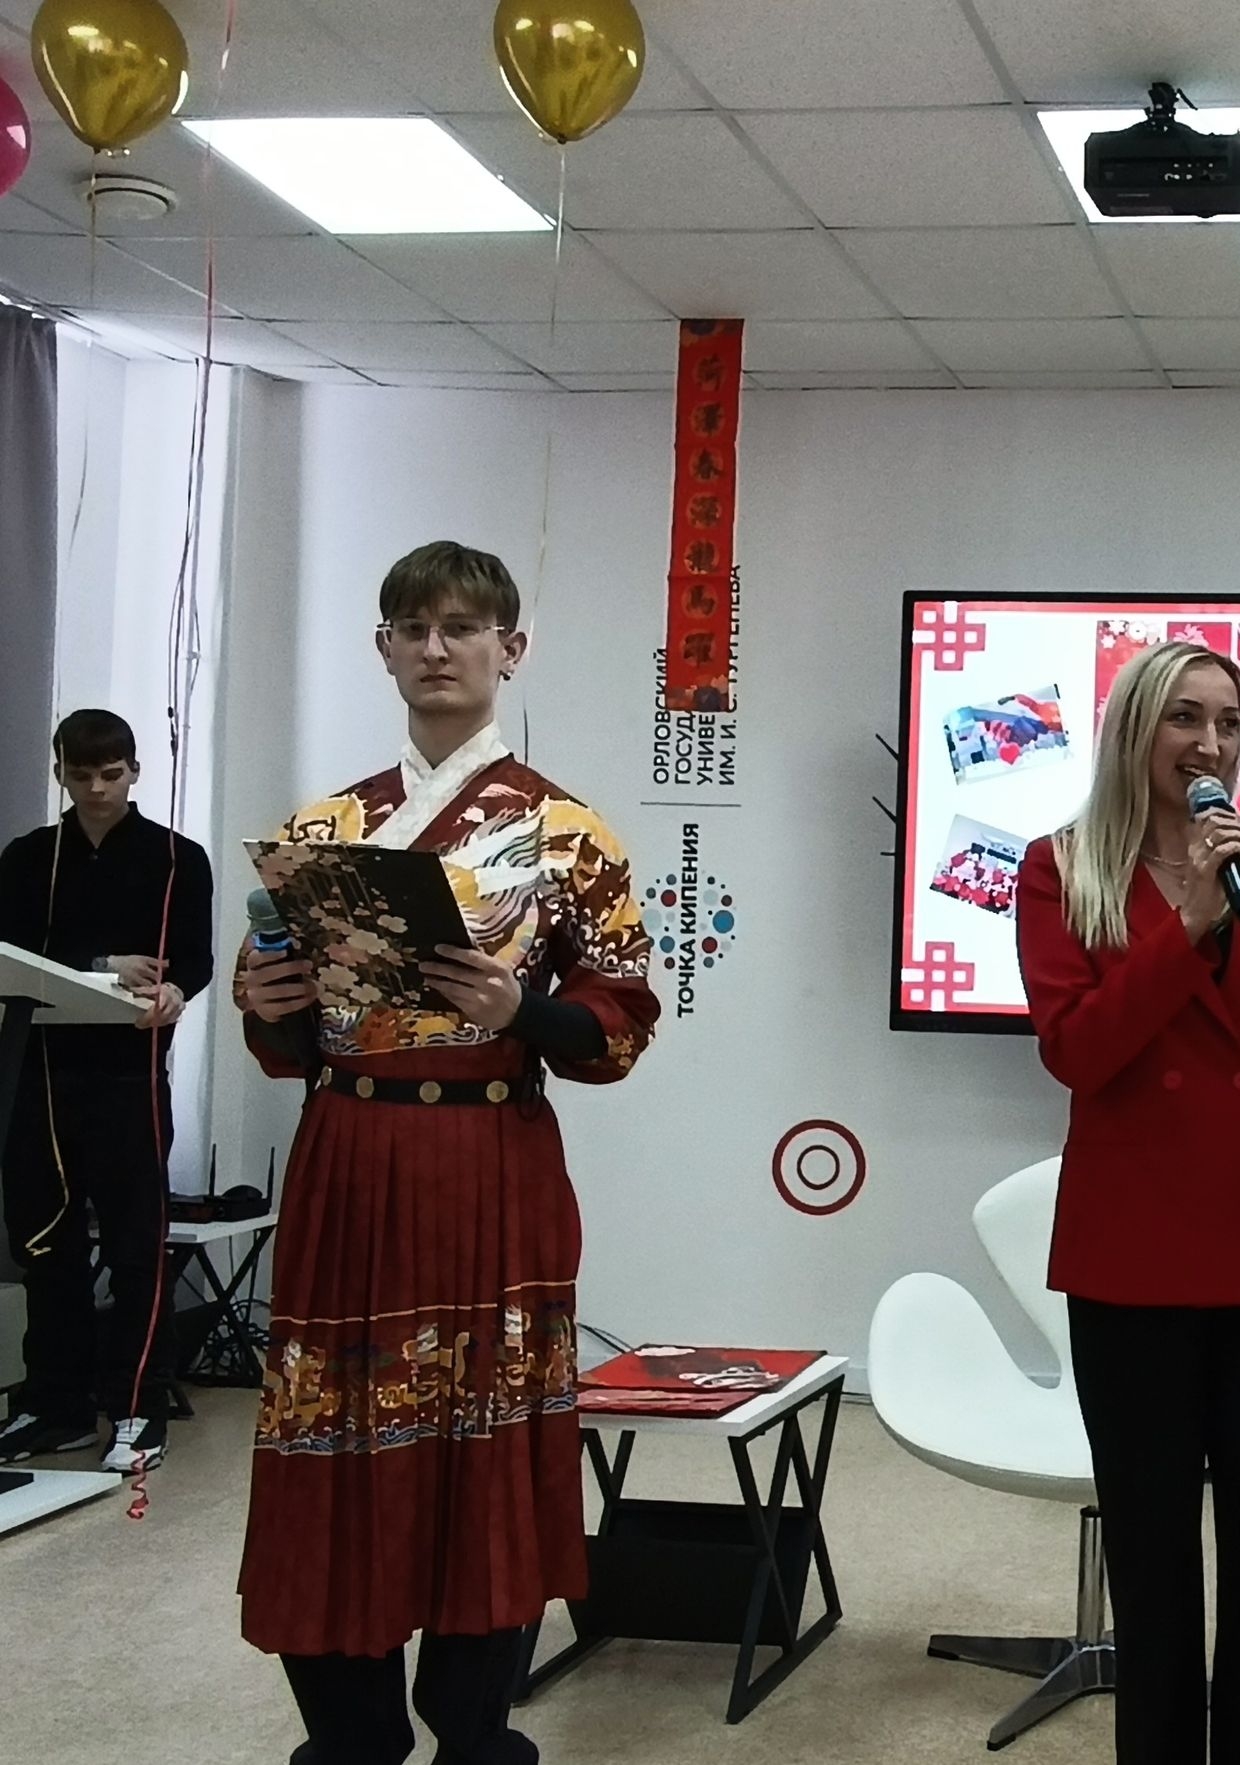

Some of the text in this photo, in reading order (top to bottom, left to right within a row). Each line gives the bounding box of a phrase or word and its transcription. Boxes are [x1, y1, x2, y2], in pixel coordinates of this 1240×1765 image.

[675, 711, 696, 785] ГОСУД
[720, 719, 737, 739] И.
[719, 745, 736, 786] ИМ.
[677, 823, 699, 1018] ТОЧКА КИПЕНИЯ
